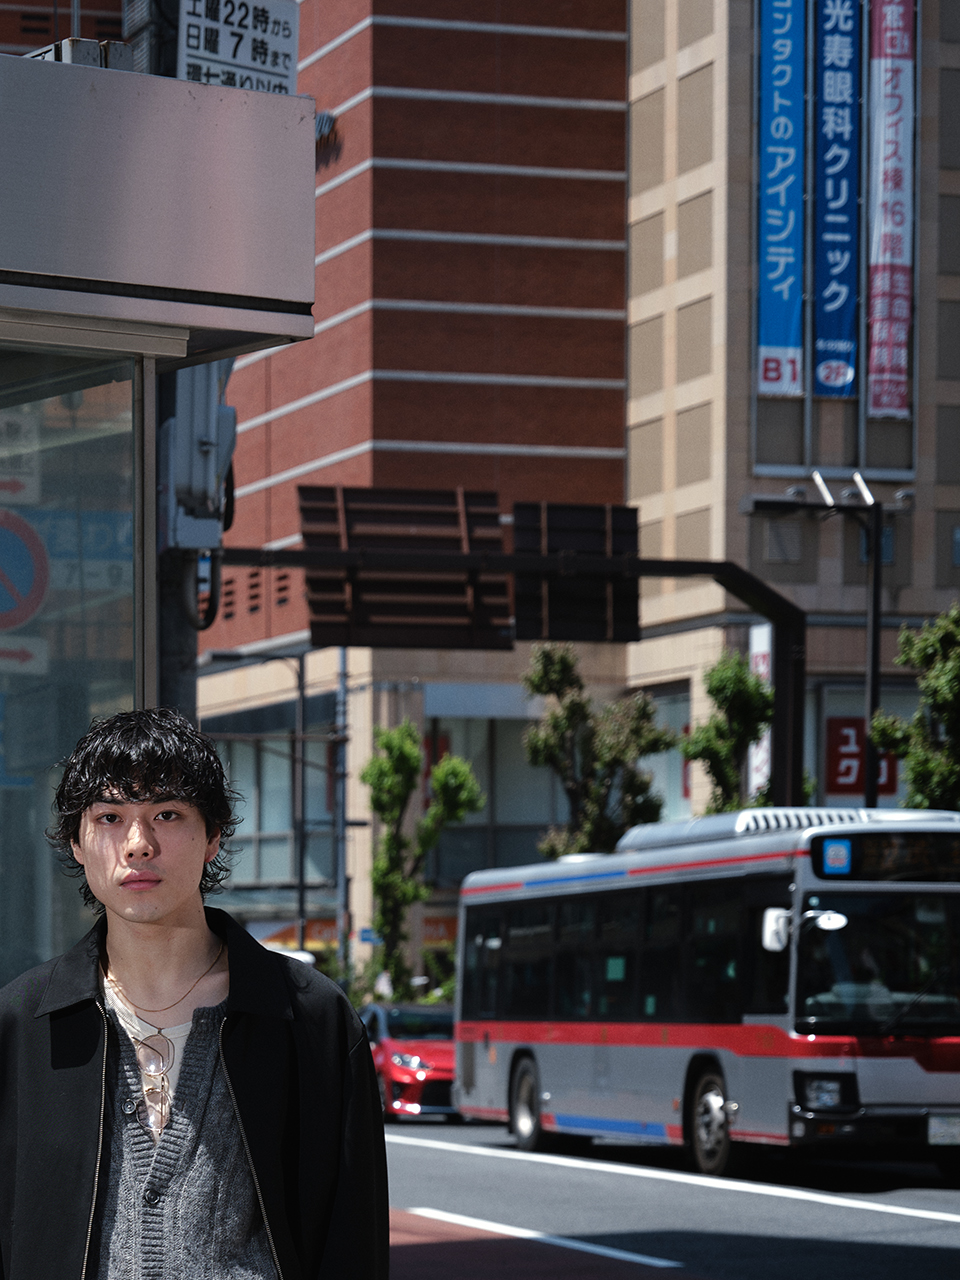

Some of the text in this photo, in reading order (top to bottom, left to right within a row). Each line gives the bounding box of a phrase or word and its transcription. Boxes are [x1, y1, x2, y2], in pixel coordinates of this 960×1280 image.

[187, 0, 292, 39] 土曜22時から
[186, 24, 292, 70] 日曜7時まで
[822, 0, 853, 312] 光寿眼科クリニック
[762, 357, 799, 383] B1
[839, 726, 861, 755] ユ
